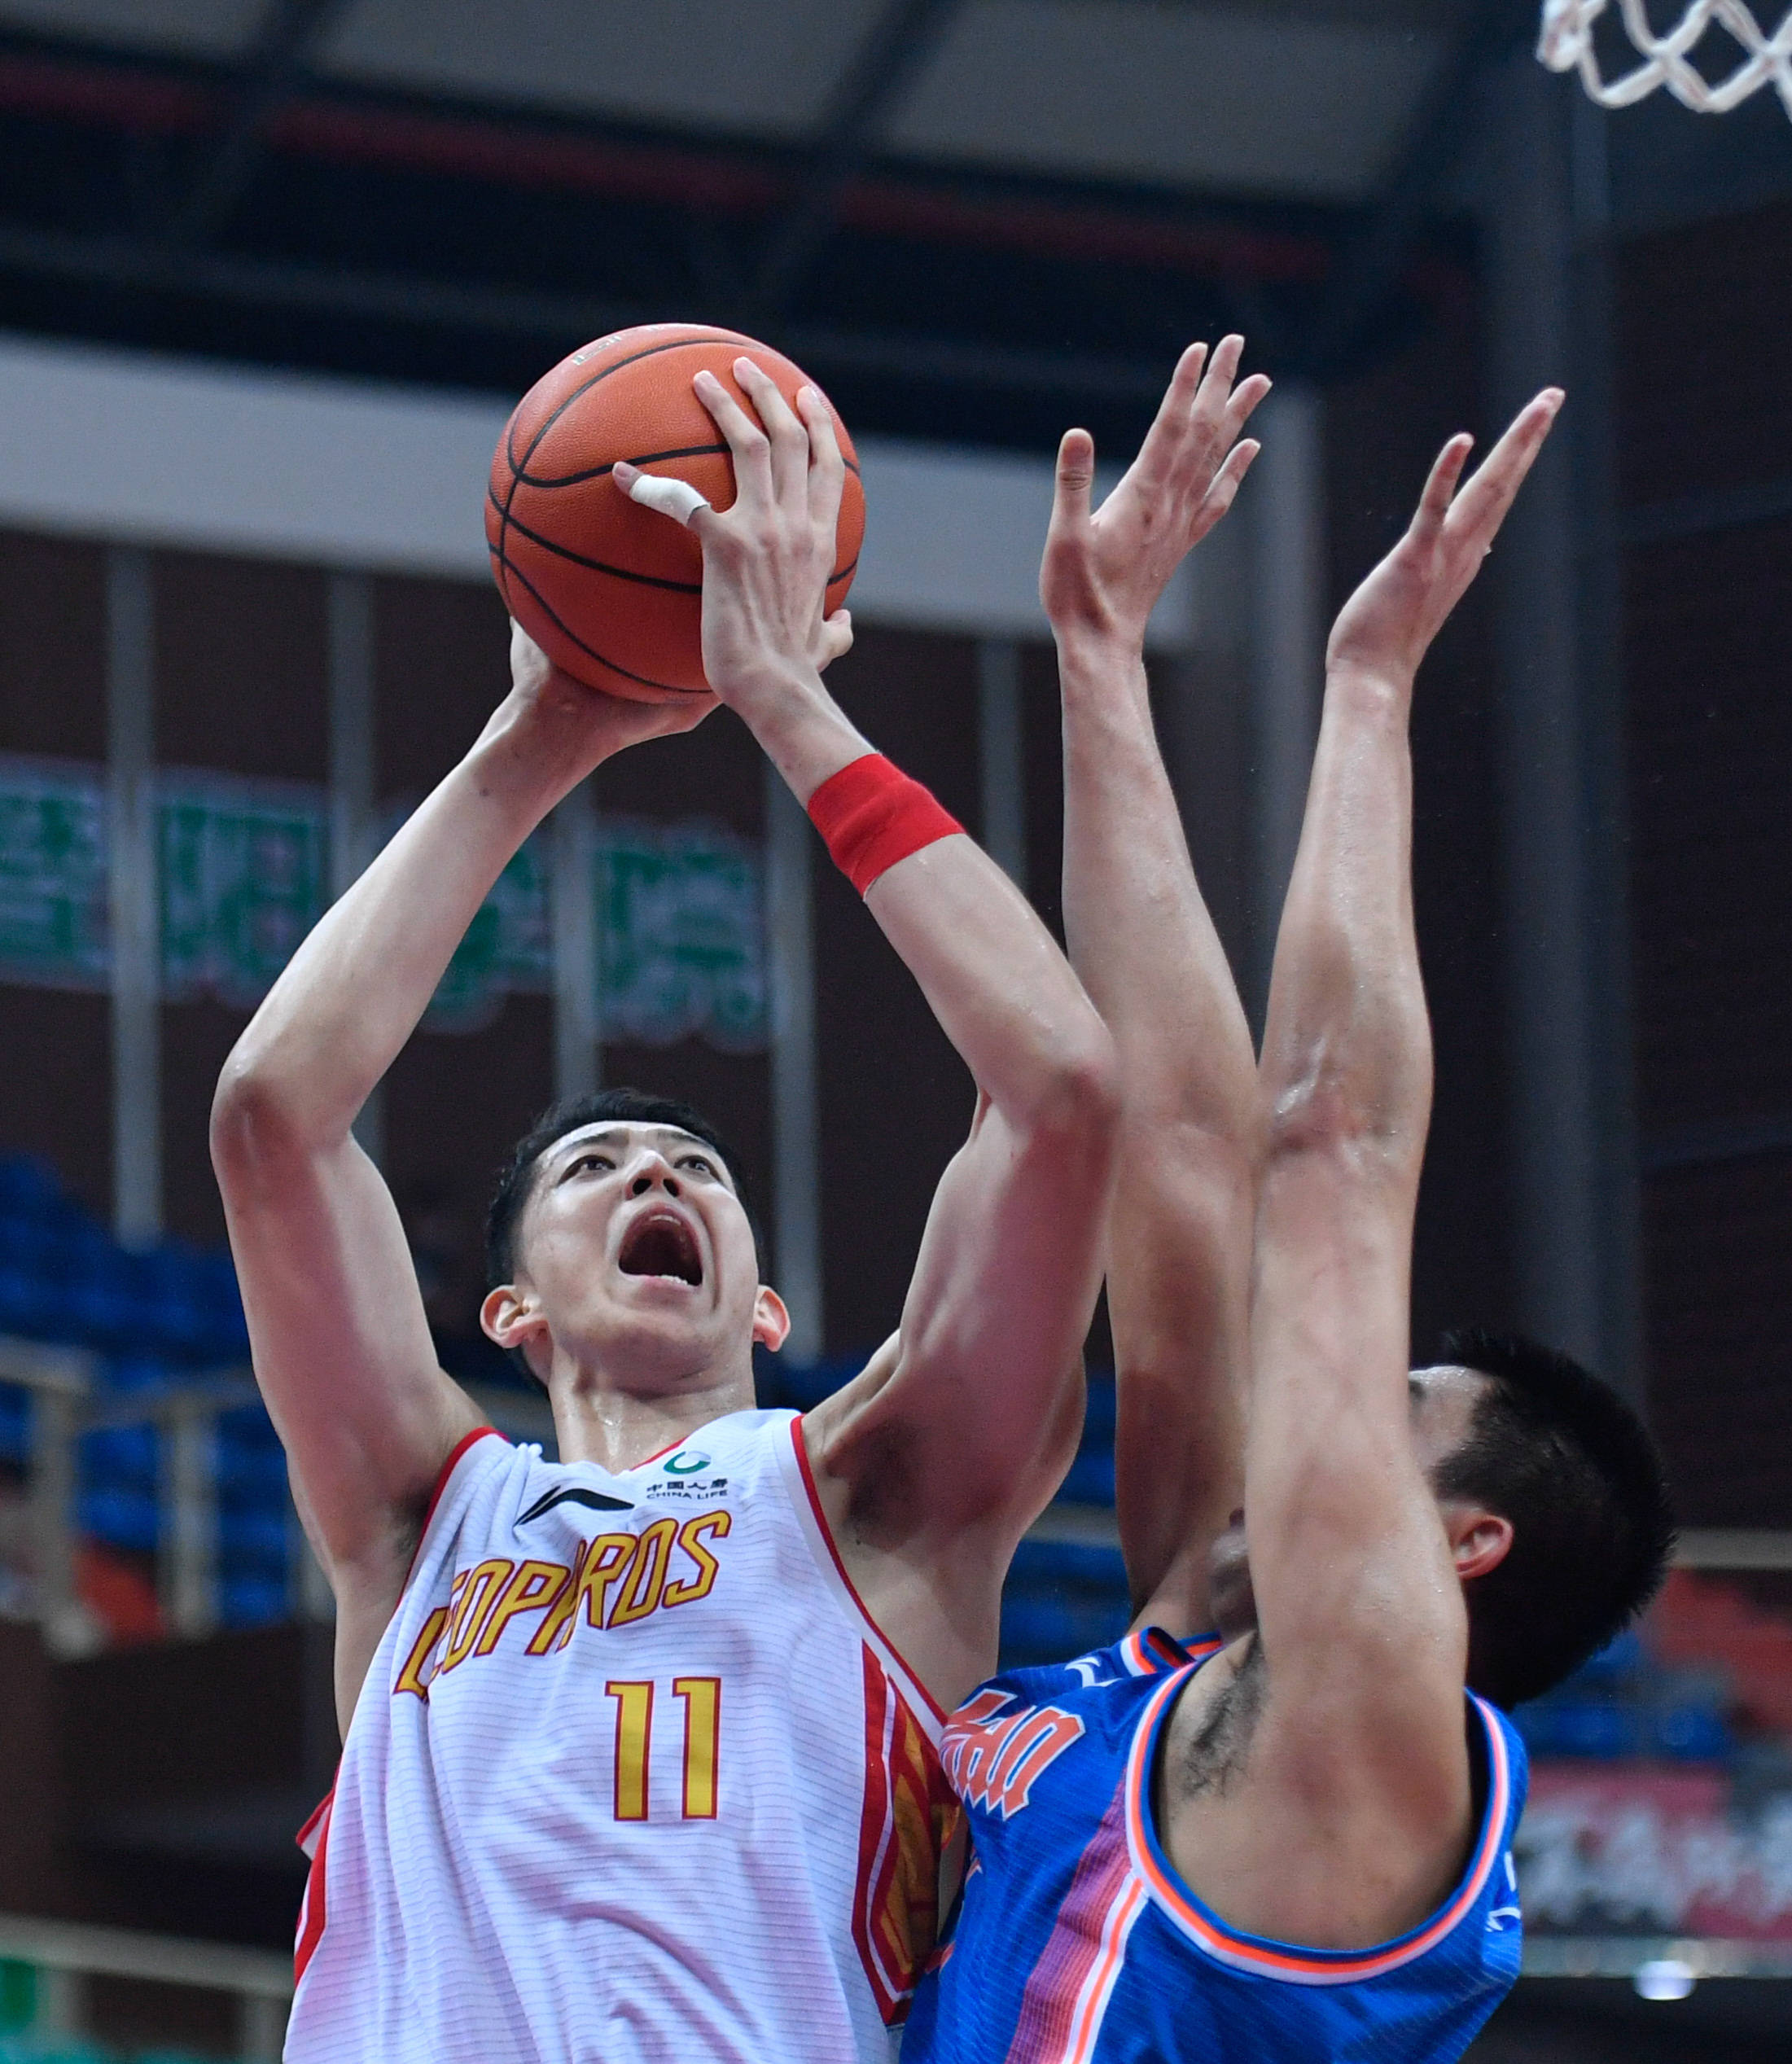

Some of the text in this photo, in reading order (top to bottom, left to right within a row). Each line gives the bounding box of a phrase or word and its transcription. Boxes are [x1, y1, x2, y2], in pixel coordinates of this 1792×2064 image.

[646, 1489, 727, 1500] CHINA LIFE
[605, 1677, 721, 1821] 11
